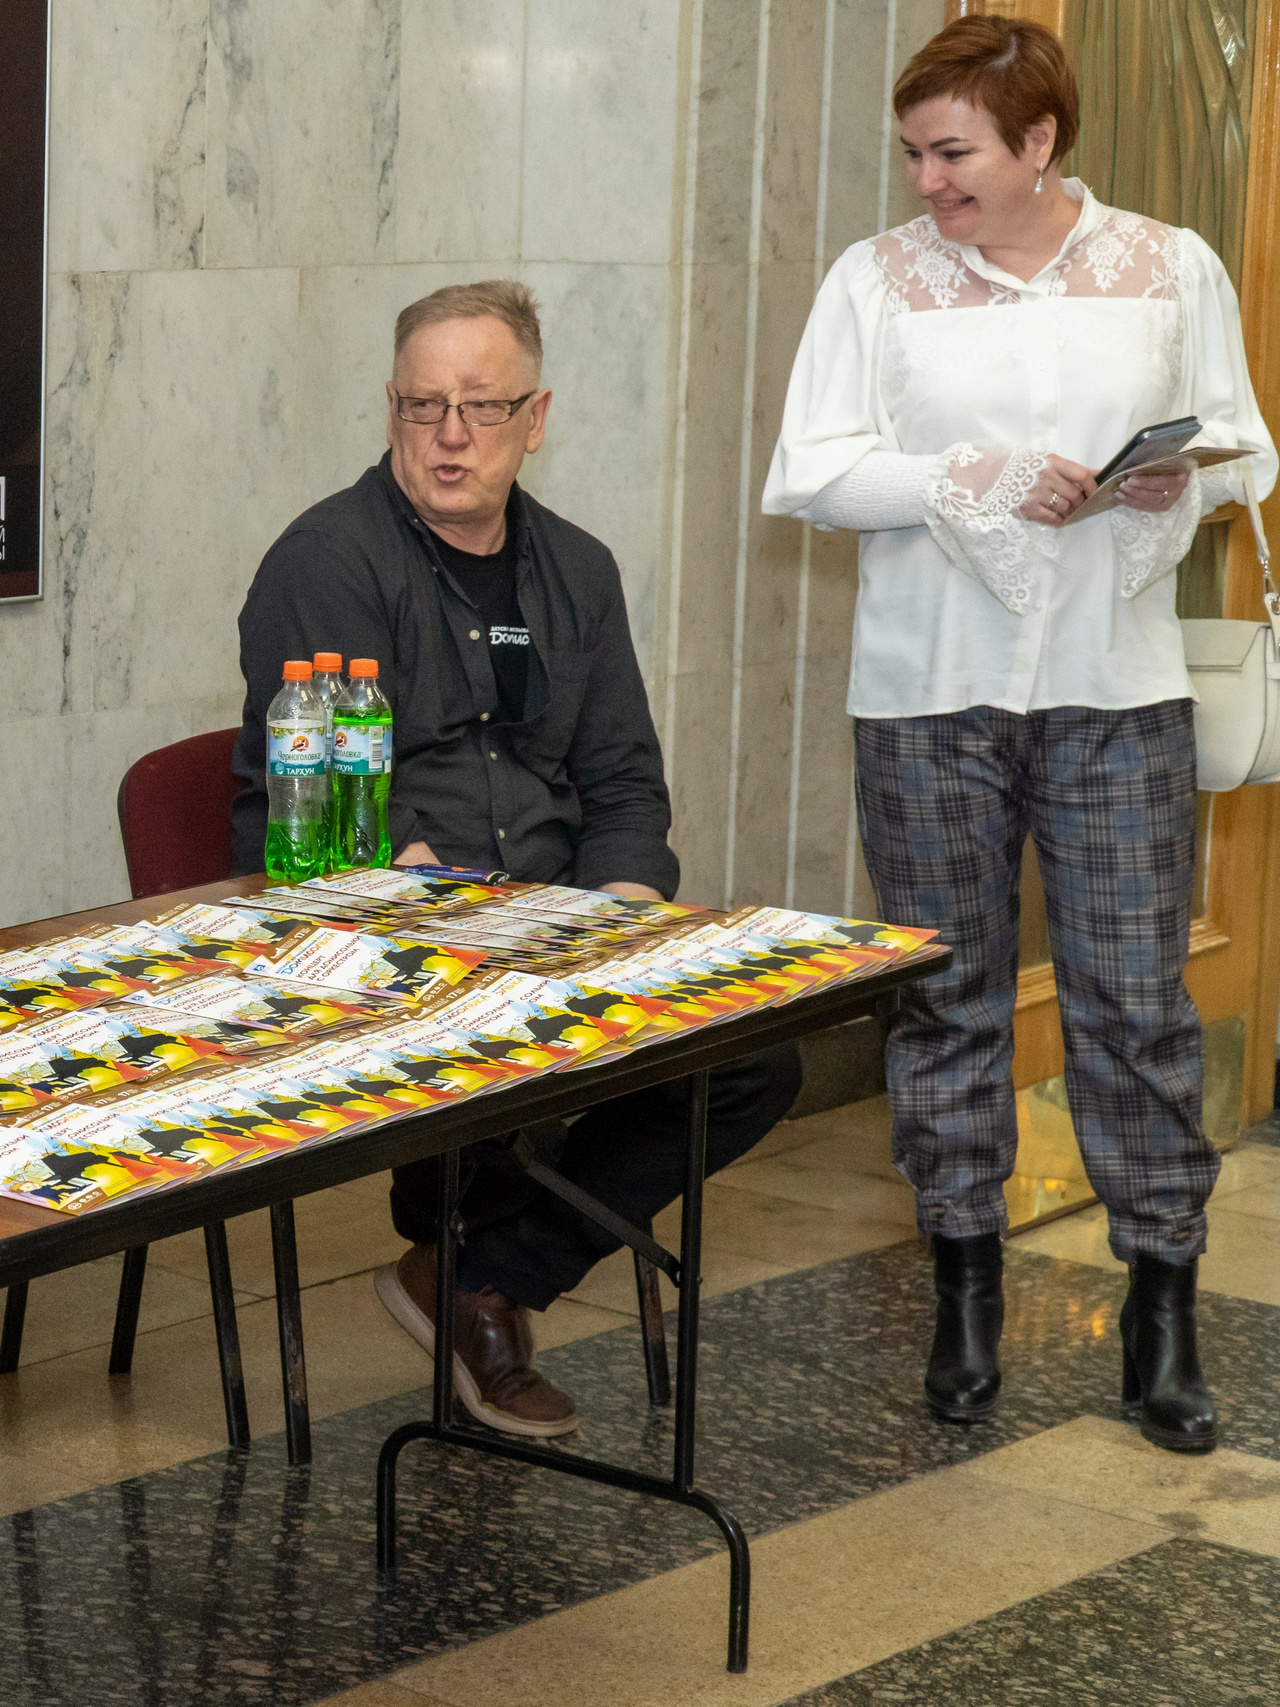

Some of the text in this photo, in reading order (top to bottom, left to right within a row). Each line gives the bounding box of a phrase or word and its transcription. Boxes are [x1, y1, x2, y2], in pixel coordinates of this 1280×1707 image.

[285, 768, 315, 776] ТАРХУН
[320, 935, 363, 969] ДОМИСОЛЬКИ
[322, 948, 360, 977] ОРКЕСТРОМ
[296, 955, 326, 978] КОНЦЕРТ
[446, 991, 458, 999] 17
